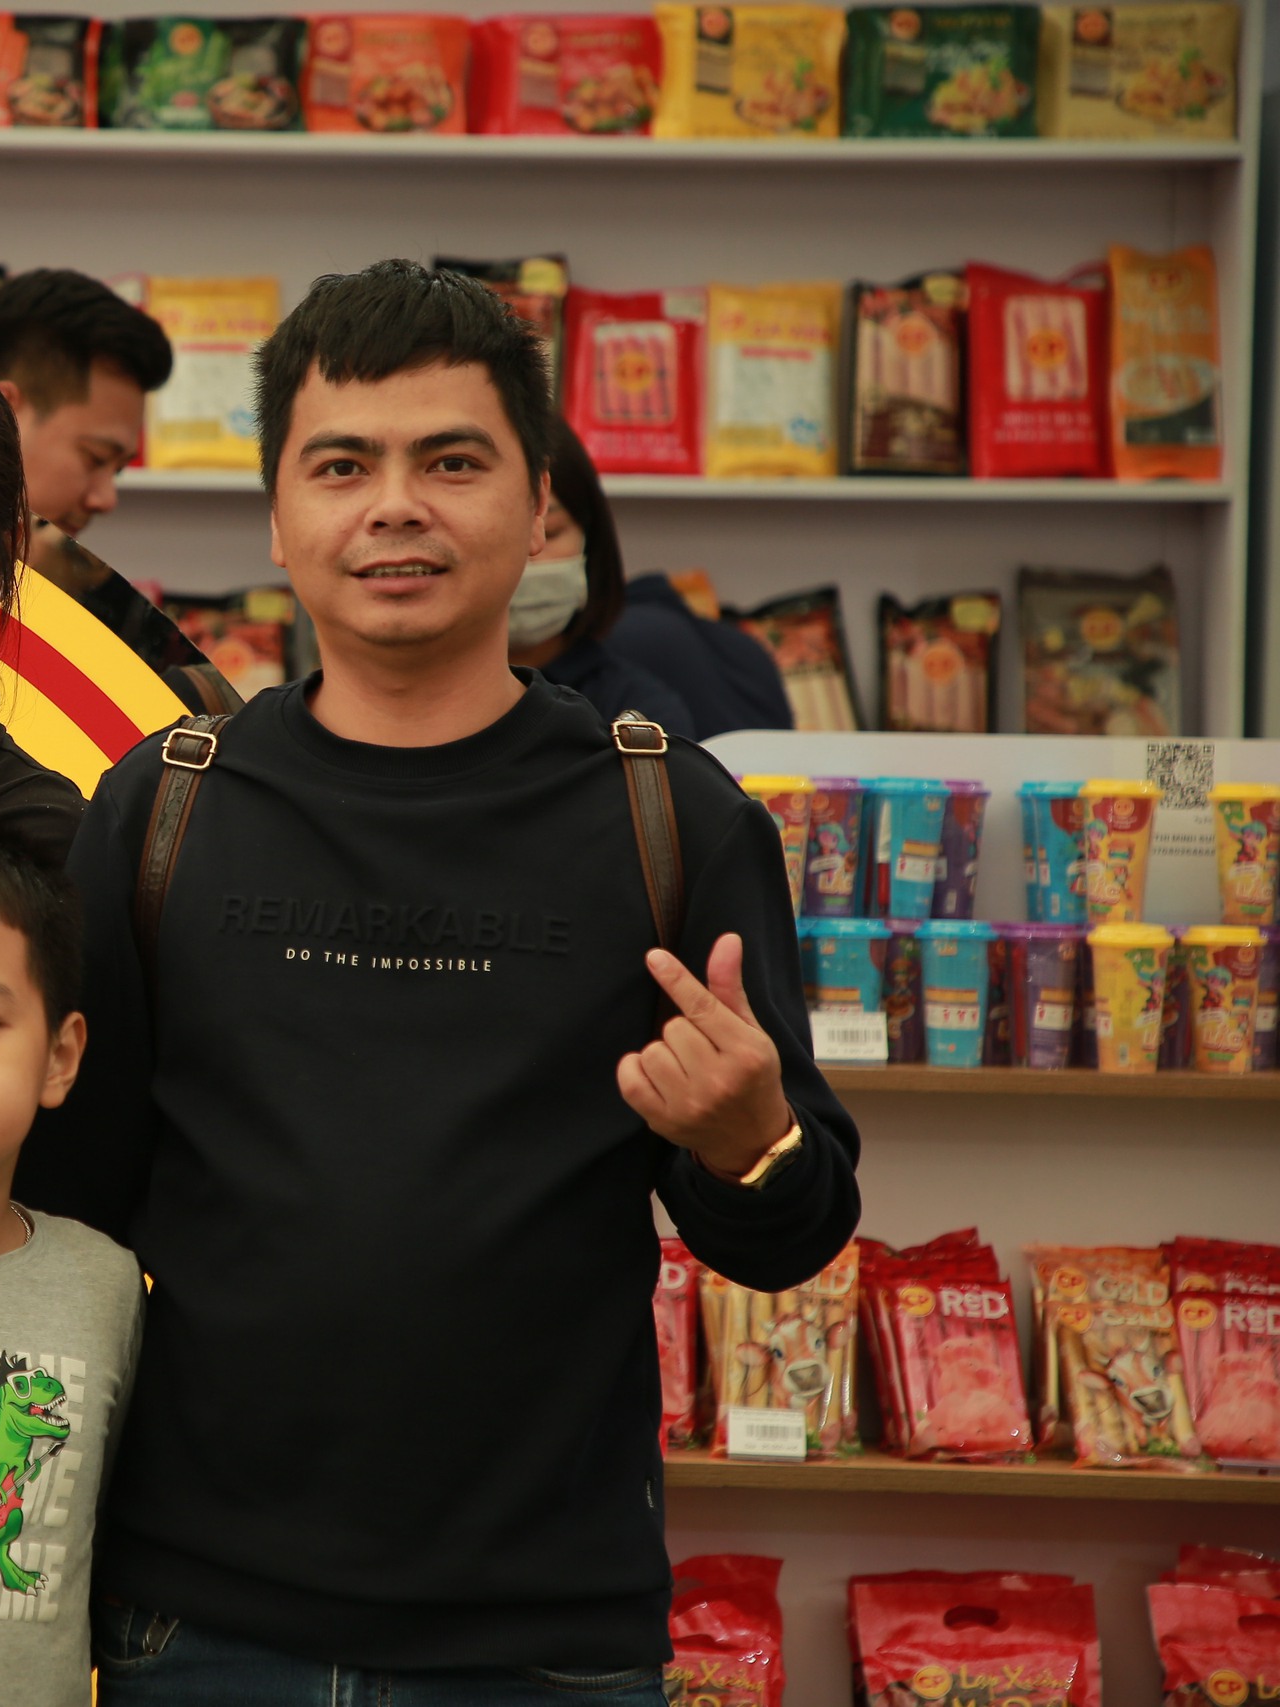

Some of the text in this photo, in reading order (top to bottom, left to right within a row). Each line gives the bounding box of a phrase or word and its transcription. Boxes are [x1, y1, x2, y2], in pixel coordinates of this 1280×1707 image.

[219, 894, 572, 957] REMARKABLE
[286, 948, 493, 973] DO THE IMPOSSIBLE
